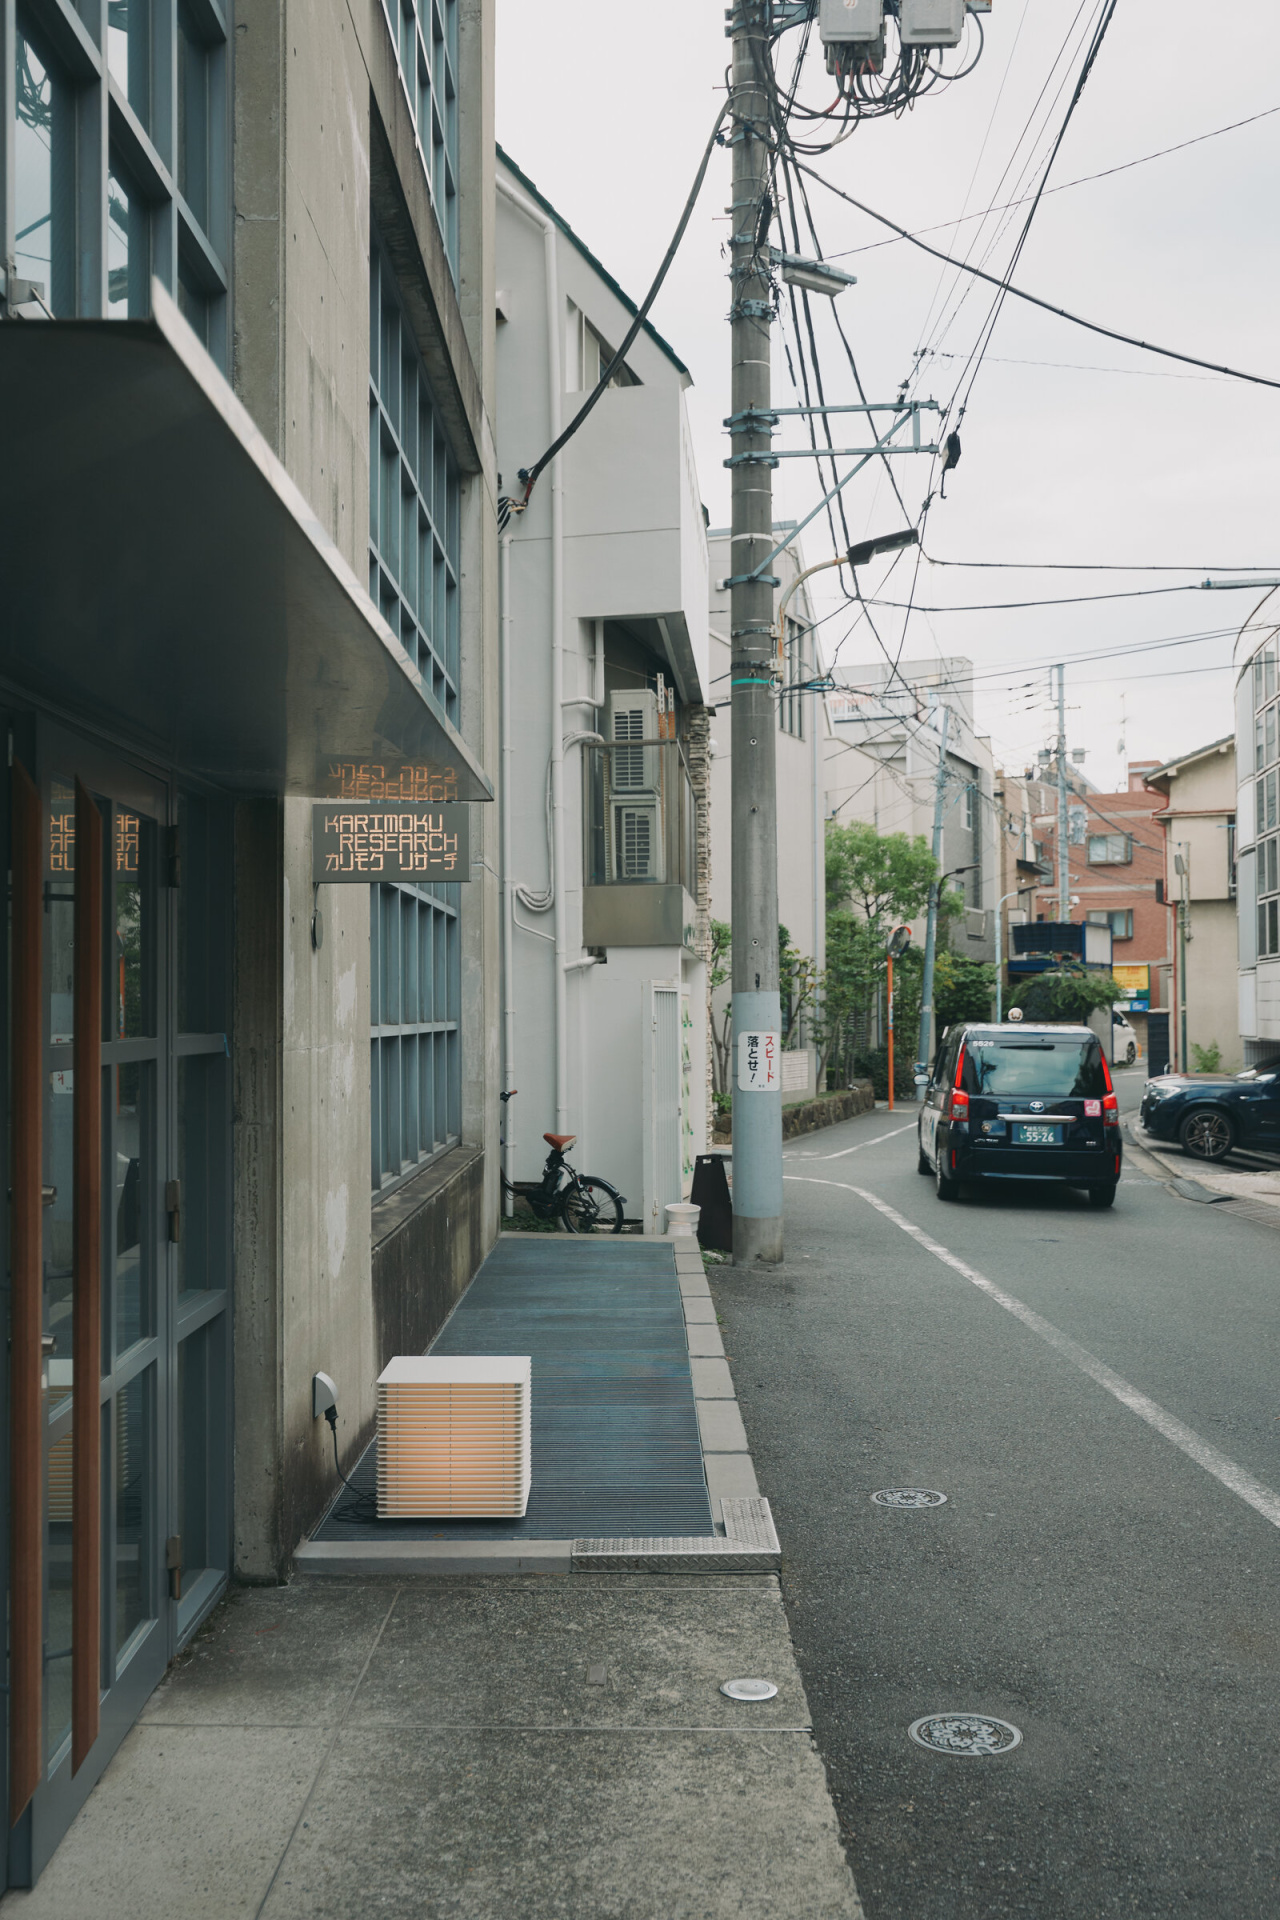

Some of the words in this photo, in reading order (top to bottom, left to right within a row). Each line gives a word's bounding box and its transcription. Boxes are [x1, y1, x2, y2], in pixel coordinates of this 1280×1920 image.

[325, 814, 443, 833] KARIMOKU
[339, 833, 458, 852] RESEARCH
[325, 852, 384, 871] カリモク
[398, 852, 458, 871] リサーチ
[747, 1035, 759, 1082] 落とせ!
[765, 1036, 775, 1082] スピード
[1026, 1132, 1054, 1142] 55-26
